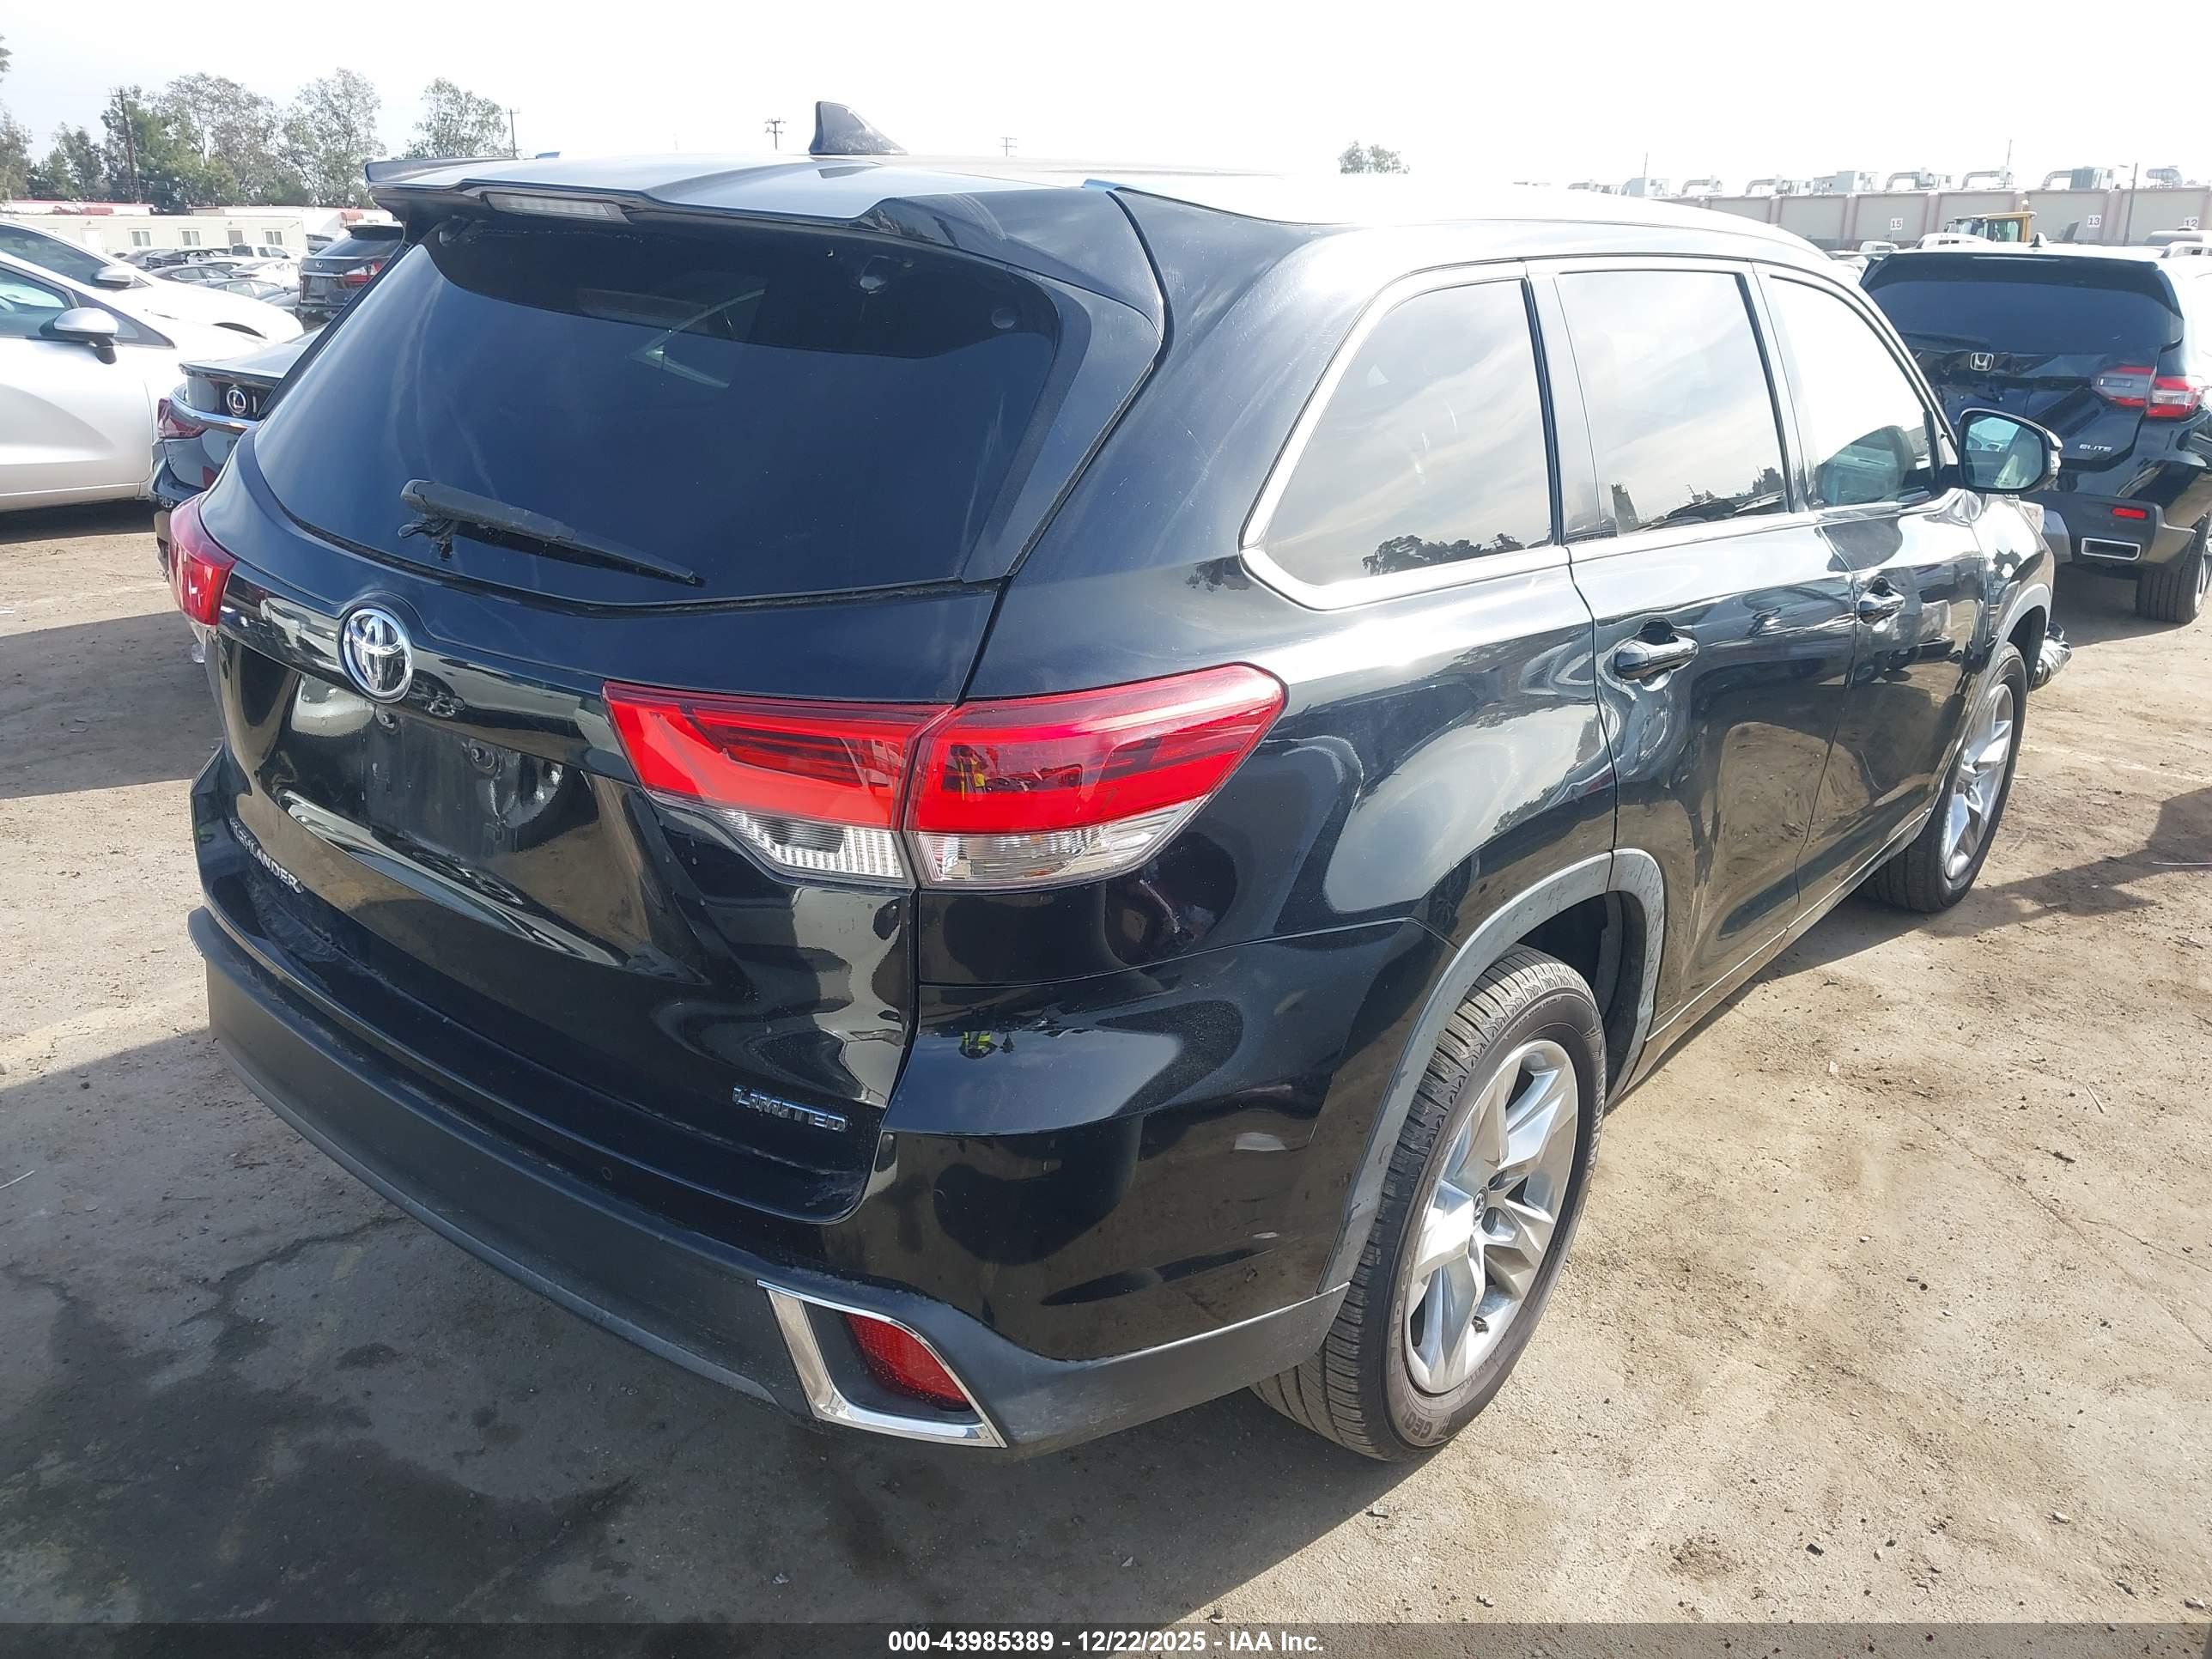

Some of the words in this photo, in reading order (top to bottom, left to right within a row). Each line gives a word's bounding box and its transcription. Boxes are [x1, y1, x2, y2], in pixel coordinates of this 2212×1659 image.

[2088, 217, 2100, 226] 13
[2185, 218, 2197, 227] 12
[2079, 443, 2112, 452] ELITE
[732, 1085, 848, 1133] LIMITED
